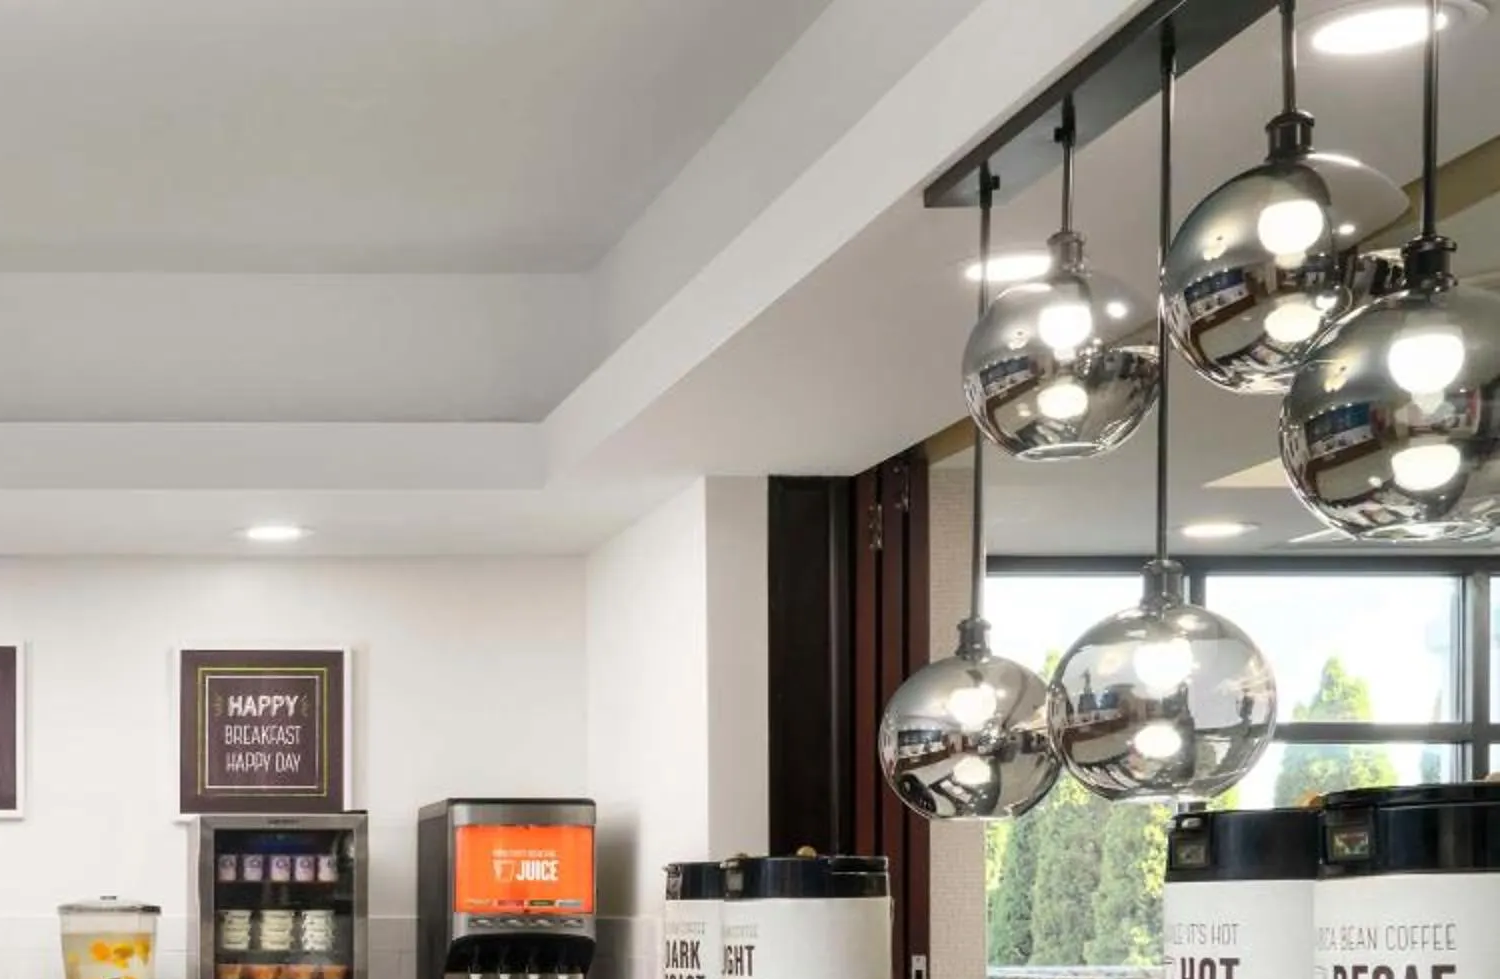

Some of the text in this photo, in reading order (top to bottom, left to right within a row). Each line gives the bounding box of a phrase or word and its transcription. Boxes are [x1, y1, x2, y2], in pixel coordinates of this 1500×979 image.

[228, 695, 299, 717] HAPPY
[225, 725, 301, 745] BREAKFAST
[225, 752, 301, 773] HAPPY DAY
[516, 859, 559, 881] JUICE
[1211, 922, 1240, 945] HOT
[1385, 923, 1457, 951] COFFEE
